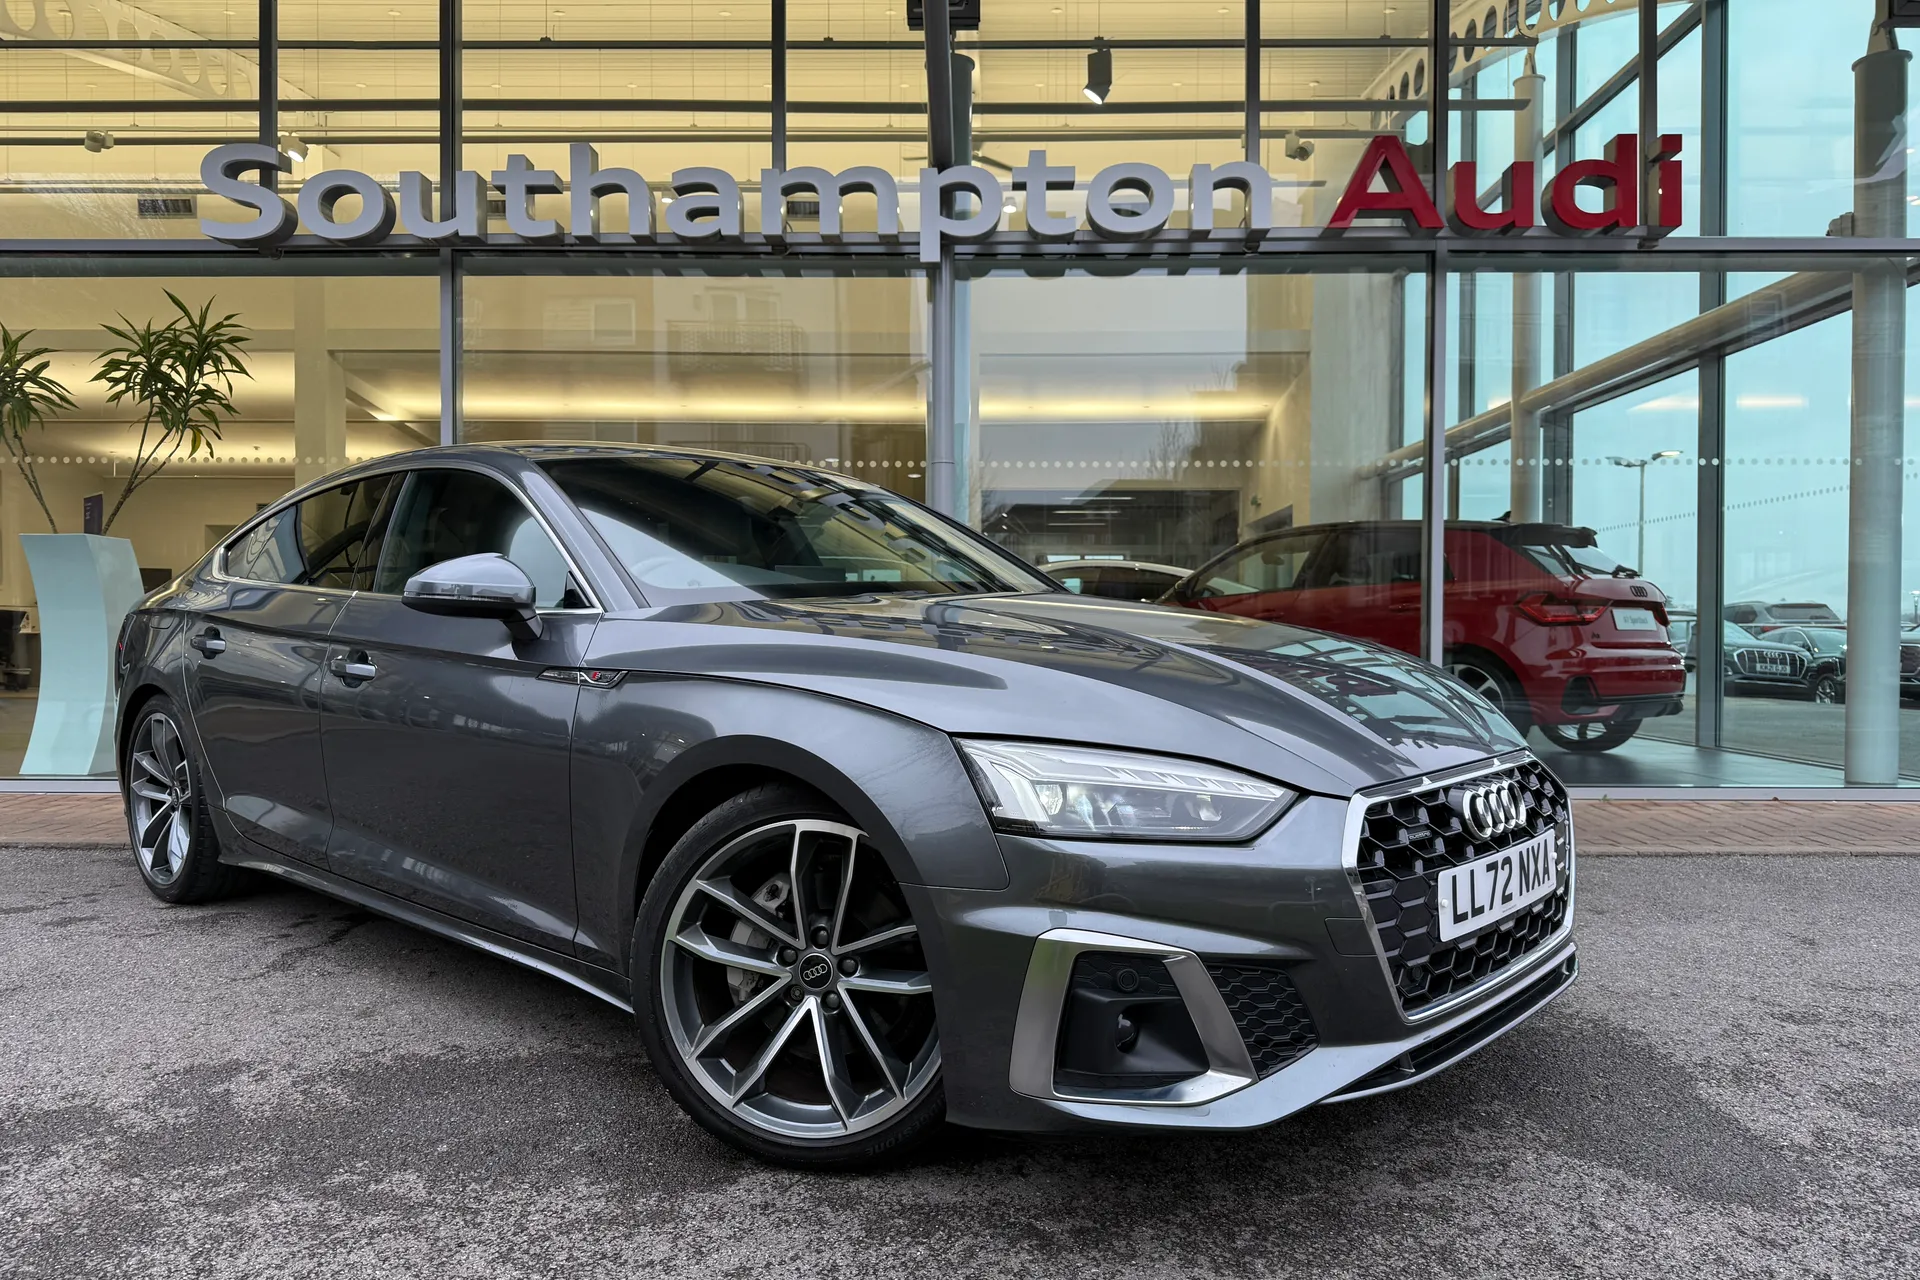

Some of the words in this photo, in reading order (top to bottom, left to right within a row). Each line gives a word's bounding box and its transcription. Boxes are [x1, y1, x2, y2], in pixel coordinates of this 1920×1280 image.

[199, 143, 1272, 262] Southampton
[1329, 133, 1683, 236] Audi
[1451, 855, 1513, 925] LL72
[1518, 838, 1551, 897] NXA
